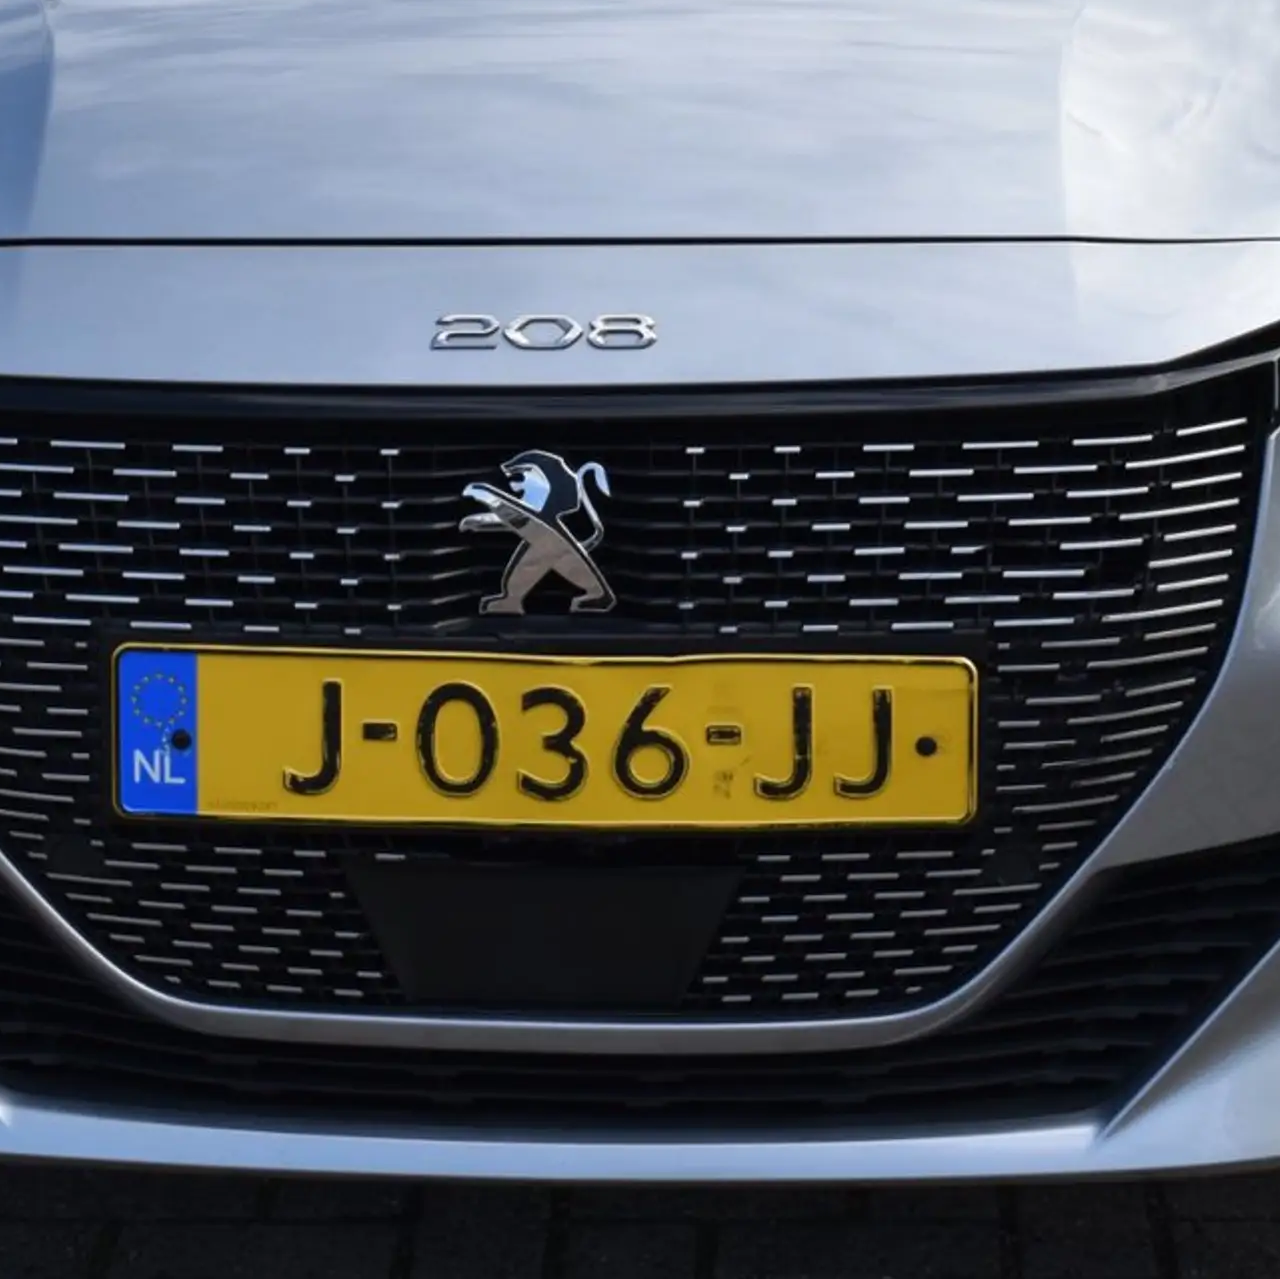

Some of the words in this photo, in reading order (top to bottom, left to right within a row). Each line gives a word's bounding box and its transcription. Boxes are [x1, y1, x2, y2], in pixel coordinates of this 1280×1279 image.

[430, 314, 657, 351] 208
[282, 677, 894, 800] J-036-JJ
[132, 748, 186, 785] NL
